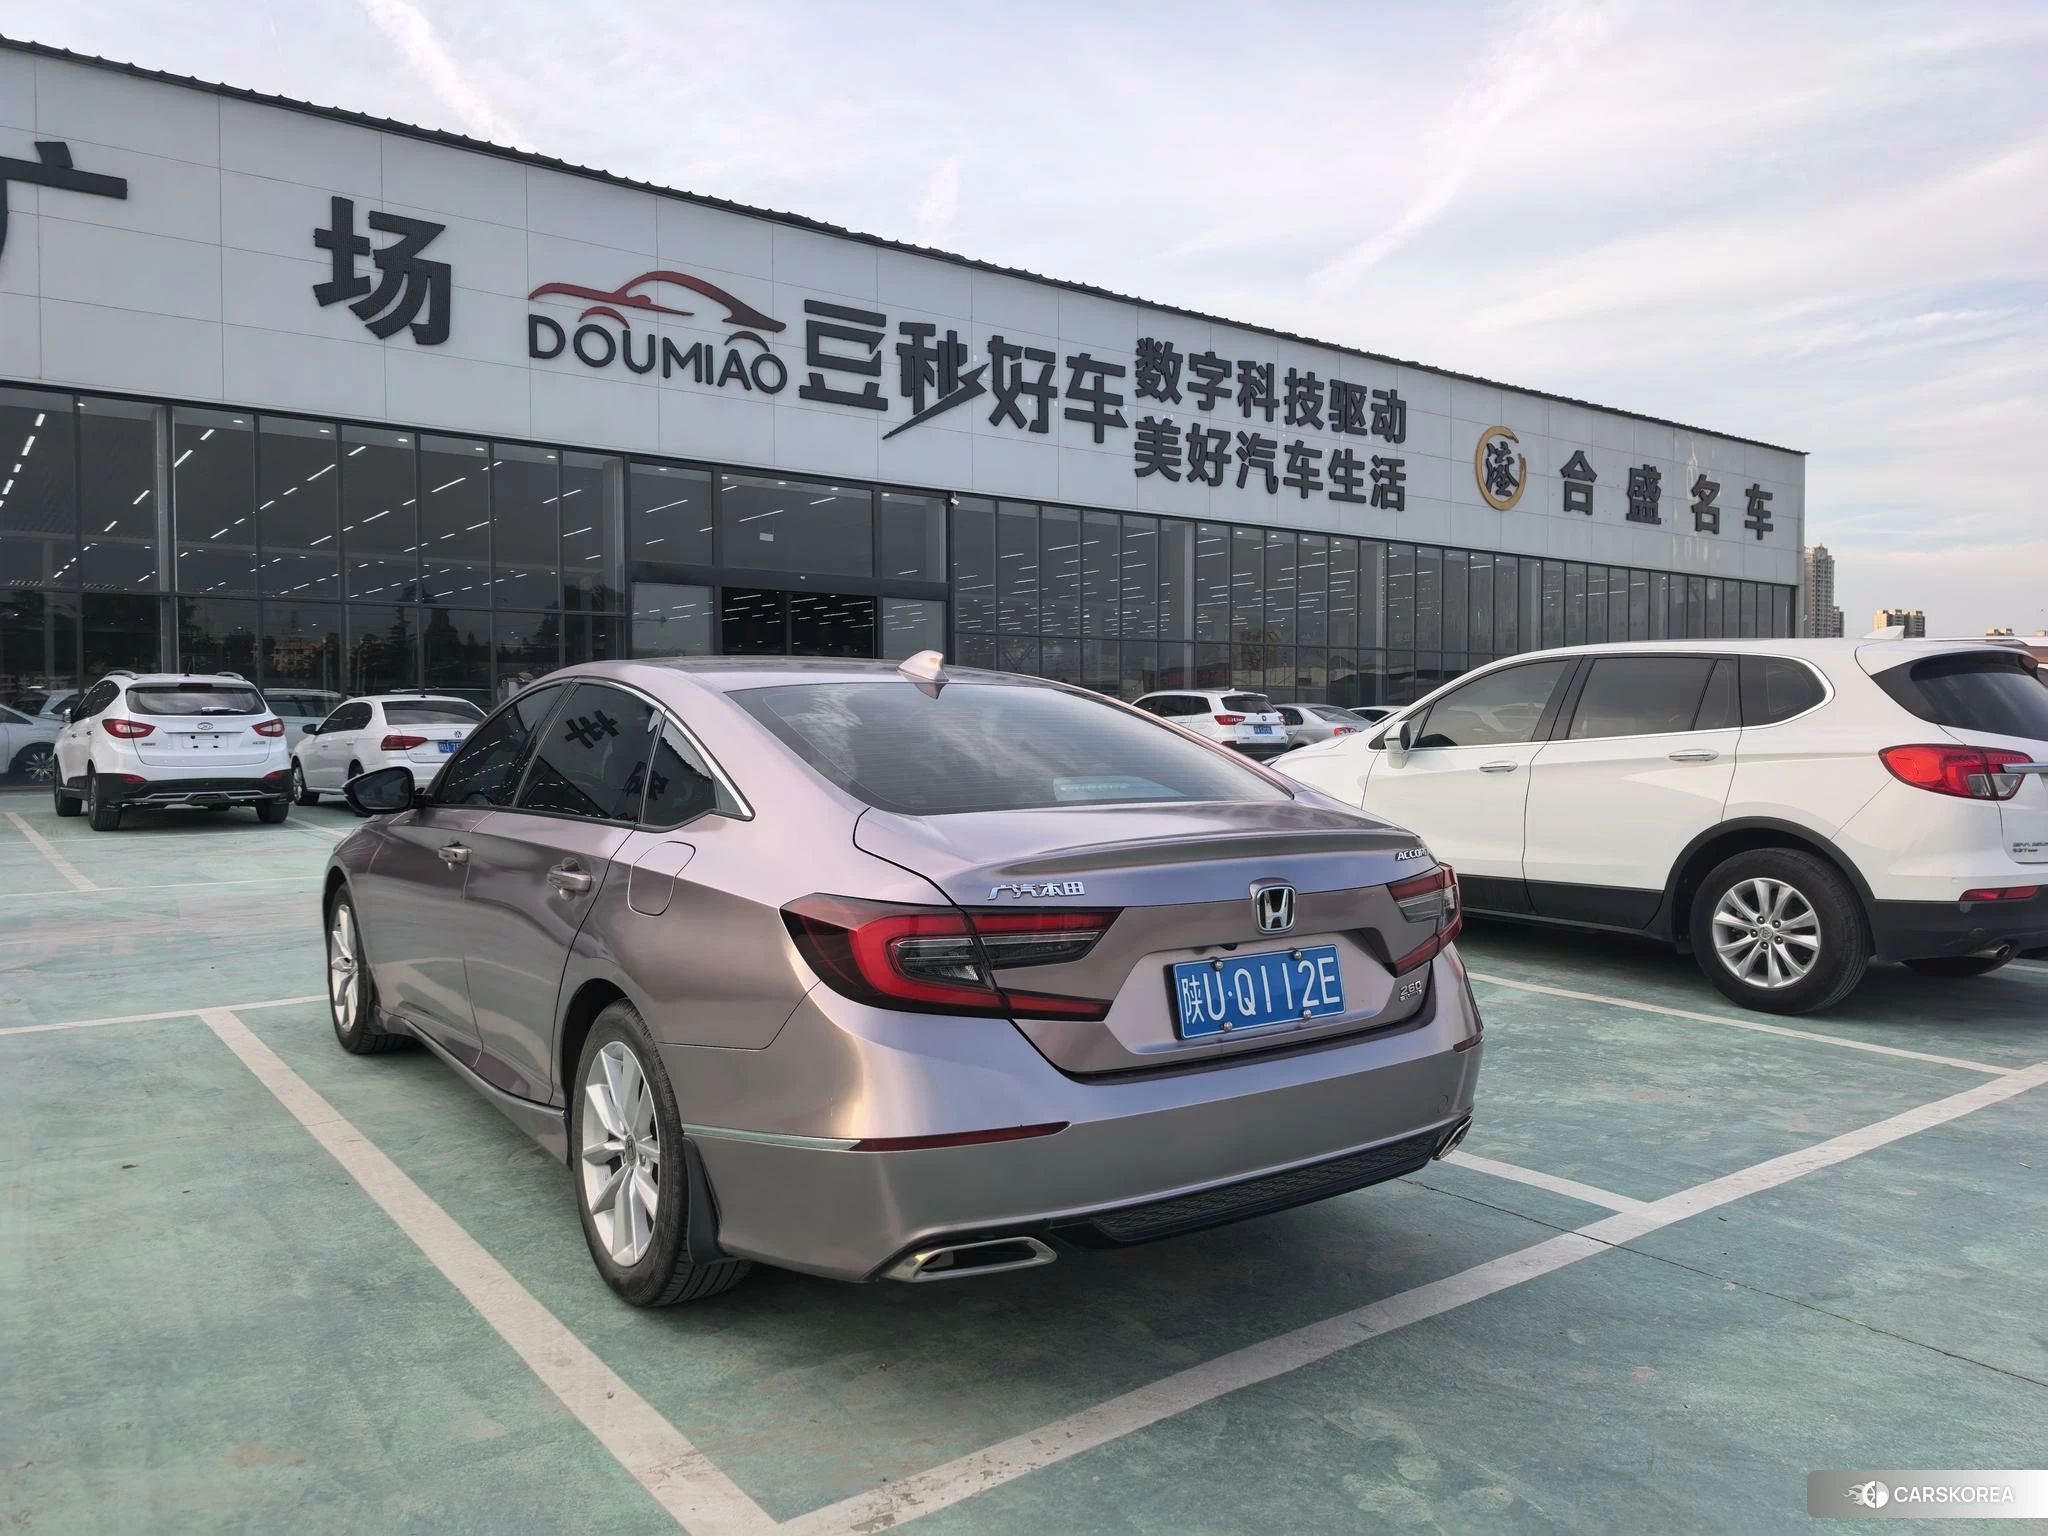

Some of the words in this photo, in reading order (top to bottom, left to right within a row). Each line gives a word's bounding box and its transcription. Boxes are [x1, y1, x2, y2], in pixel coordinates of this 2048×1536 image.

[528, 313, 788, 395] DOUMIAO
[799, 299, 1128, 441] 豆秒好车
[1135, 337, 1407, 444] 数字科技驱动
[1134, 416, 1406, 512] 美好汽车生活
[1560, 450, 1774, 540] 合盛名车
[986, 881, 1086, 900] 广汽本田
[1400, 981, 1422, 996] 260
